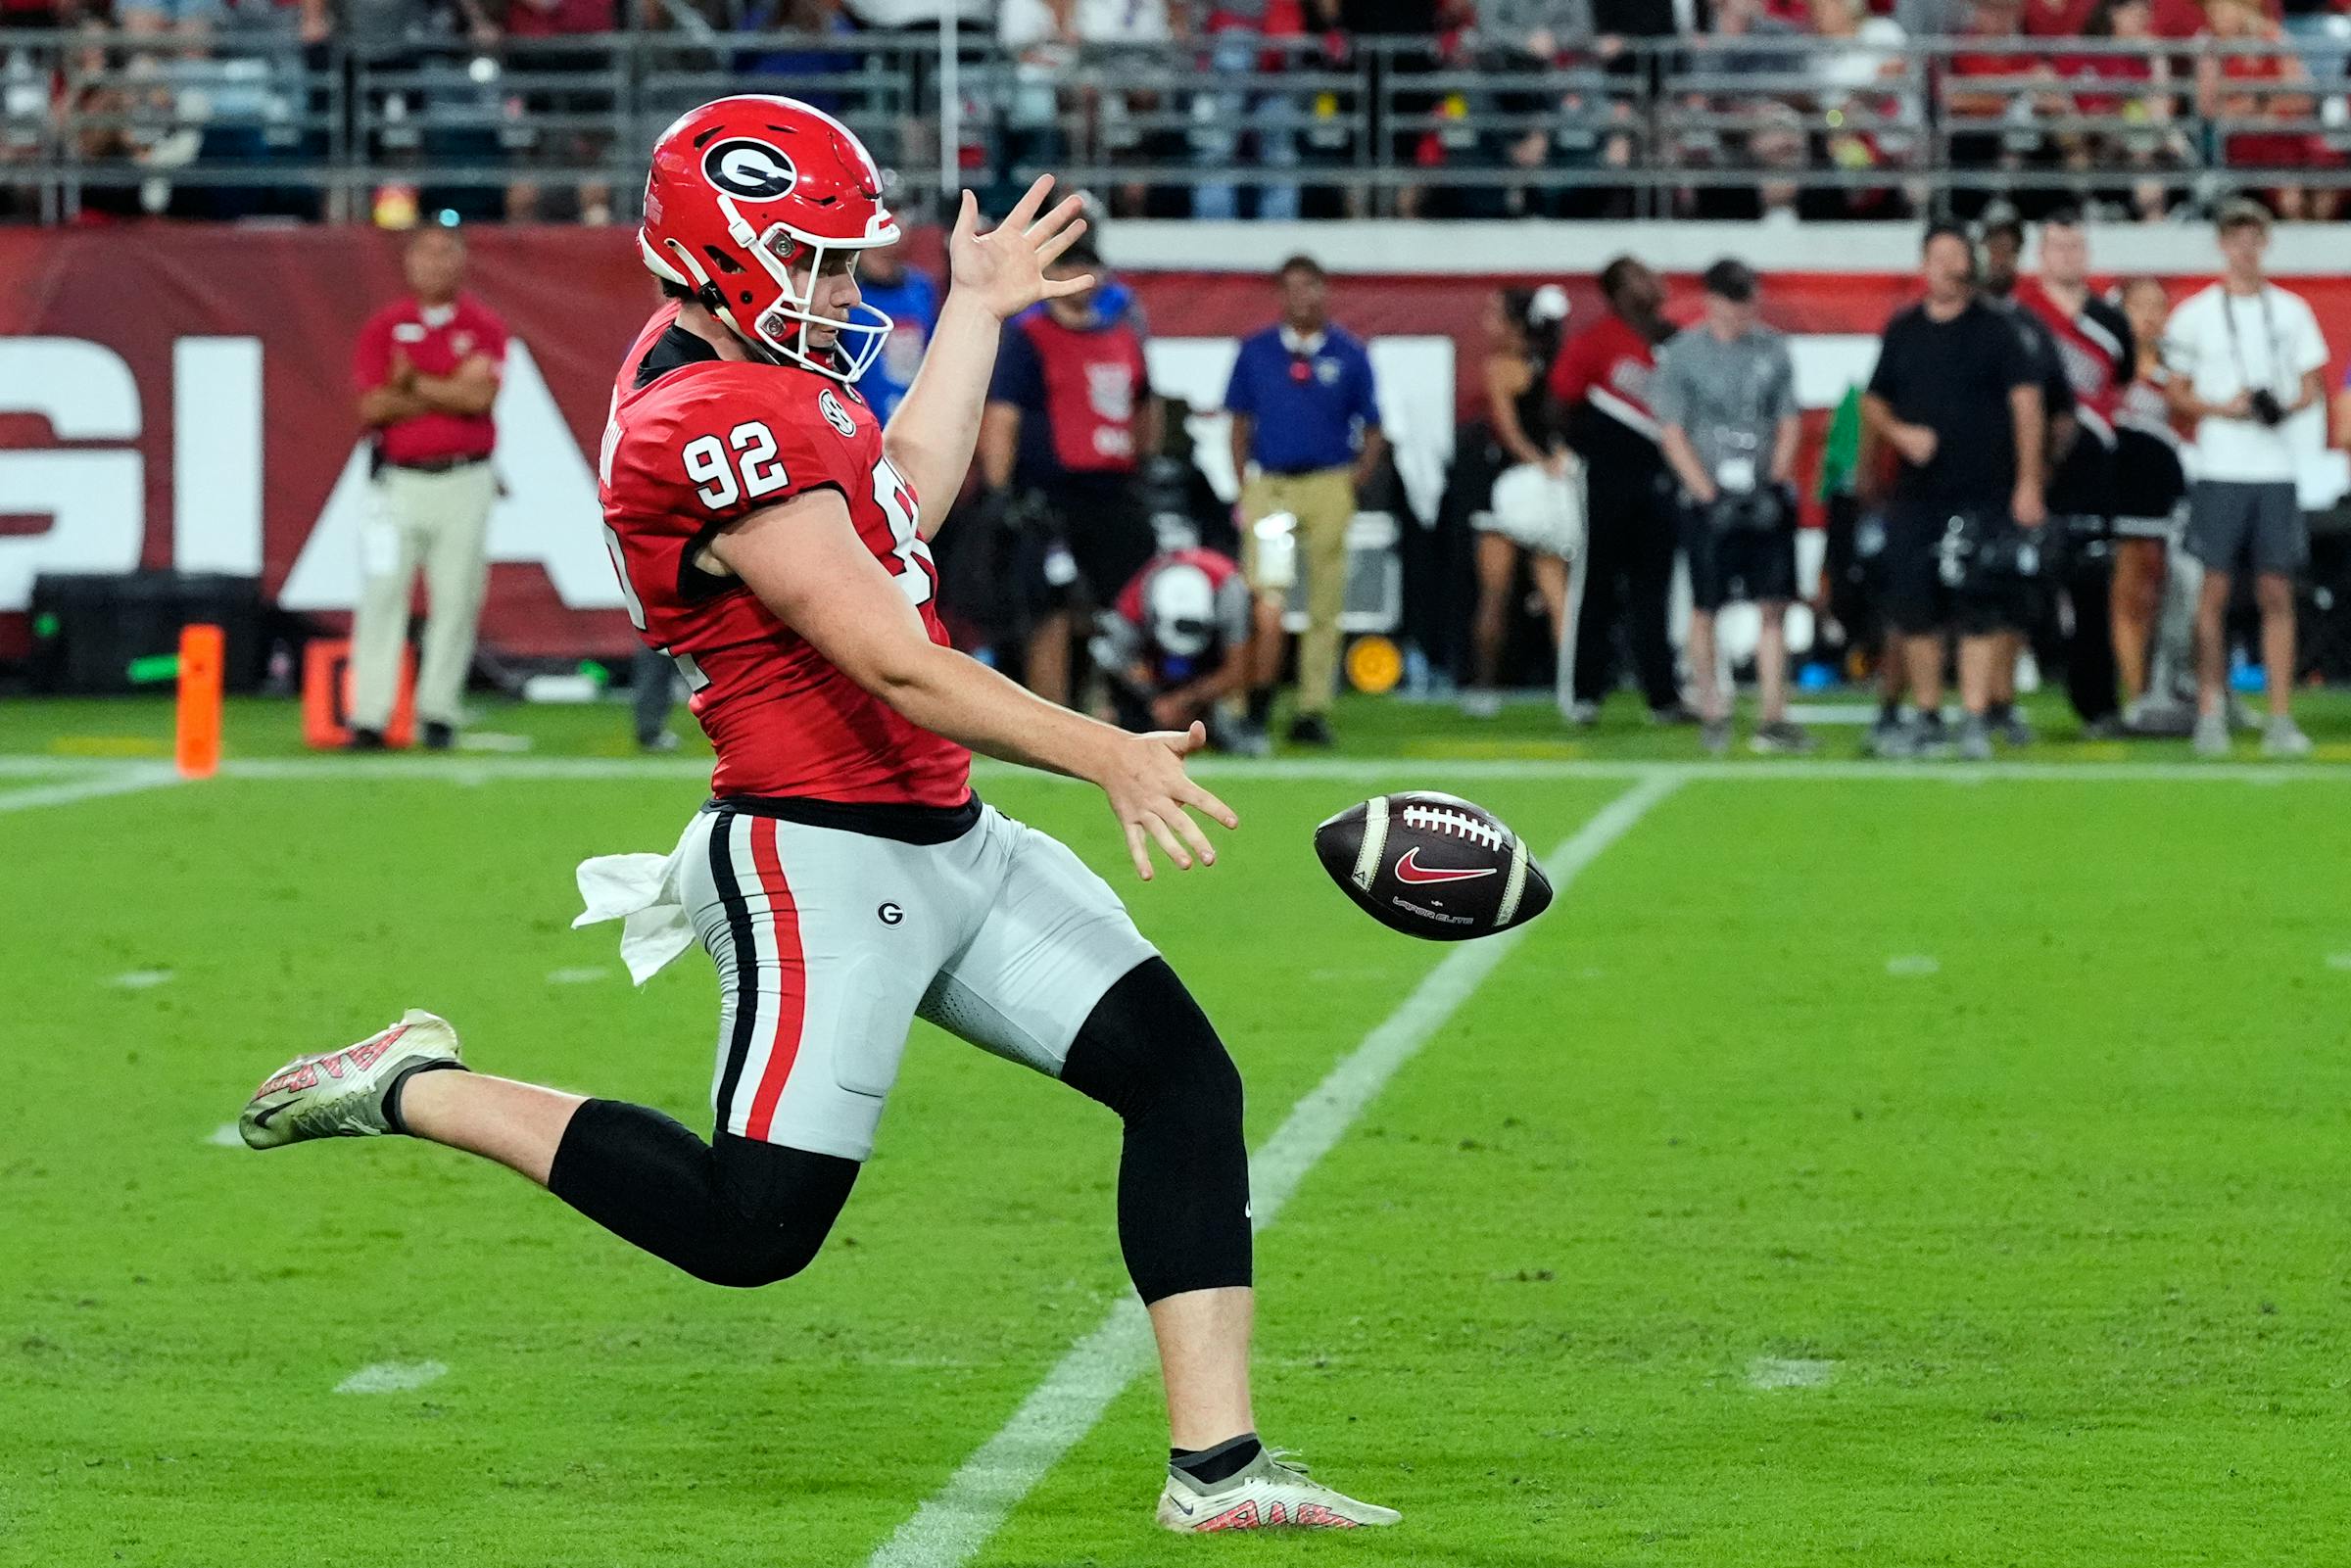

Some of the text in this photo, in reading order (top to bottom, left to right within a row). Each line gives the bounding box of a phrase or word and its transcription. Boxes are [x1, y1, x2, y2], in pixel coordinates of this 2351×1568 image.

[719, 147, 797, 188] G
[682, 420, 790, 510] 92
[878, 902, 903, 926] G
[1392, 895, 1474, 925] VAPOR ELITE
[1192, 1499, 1364, 1531] AIR
